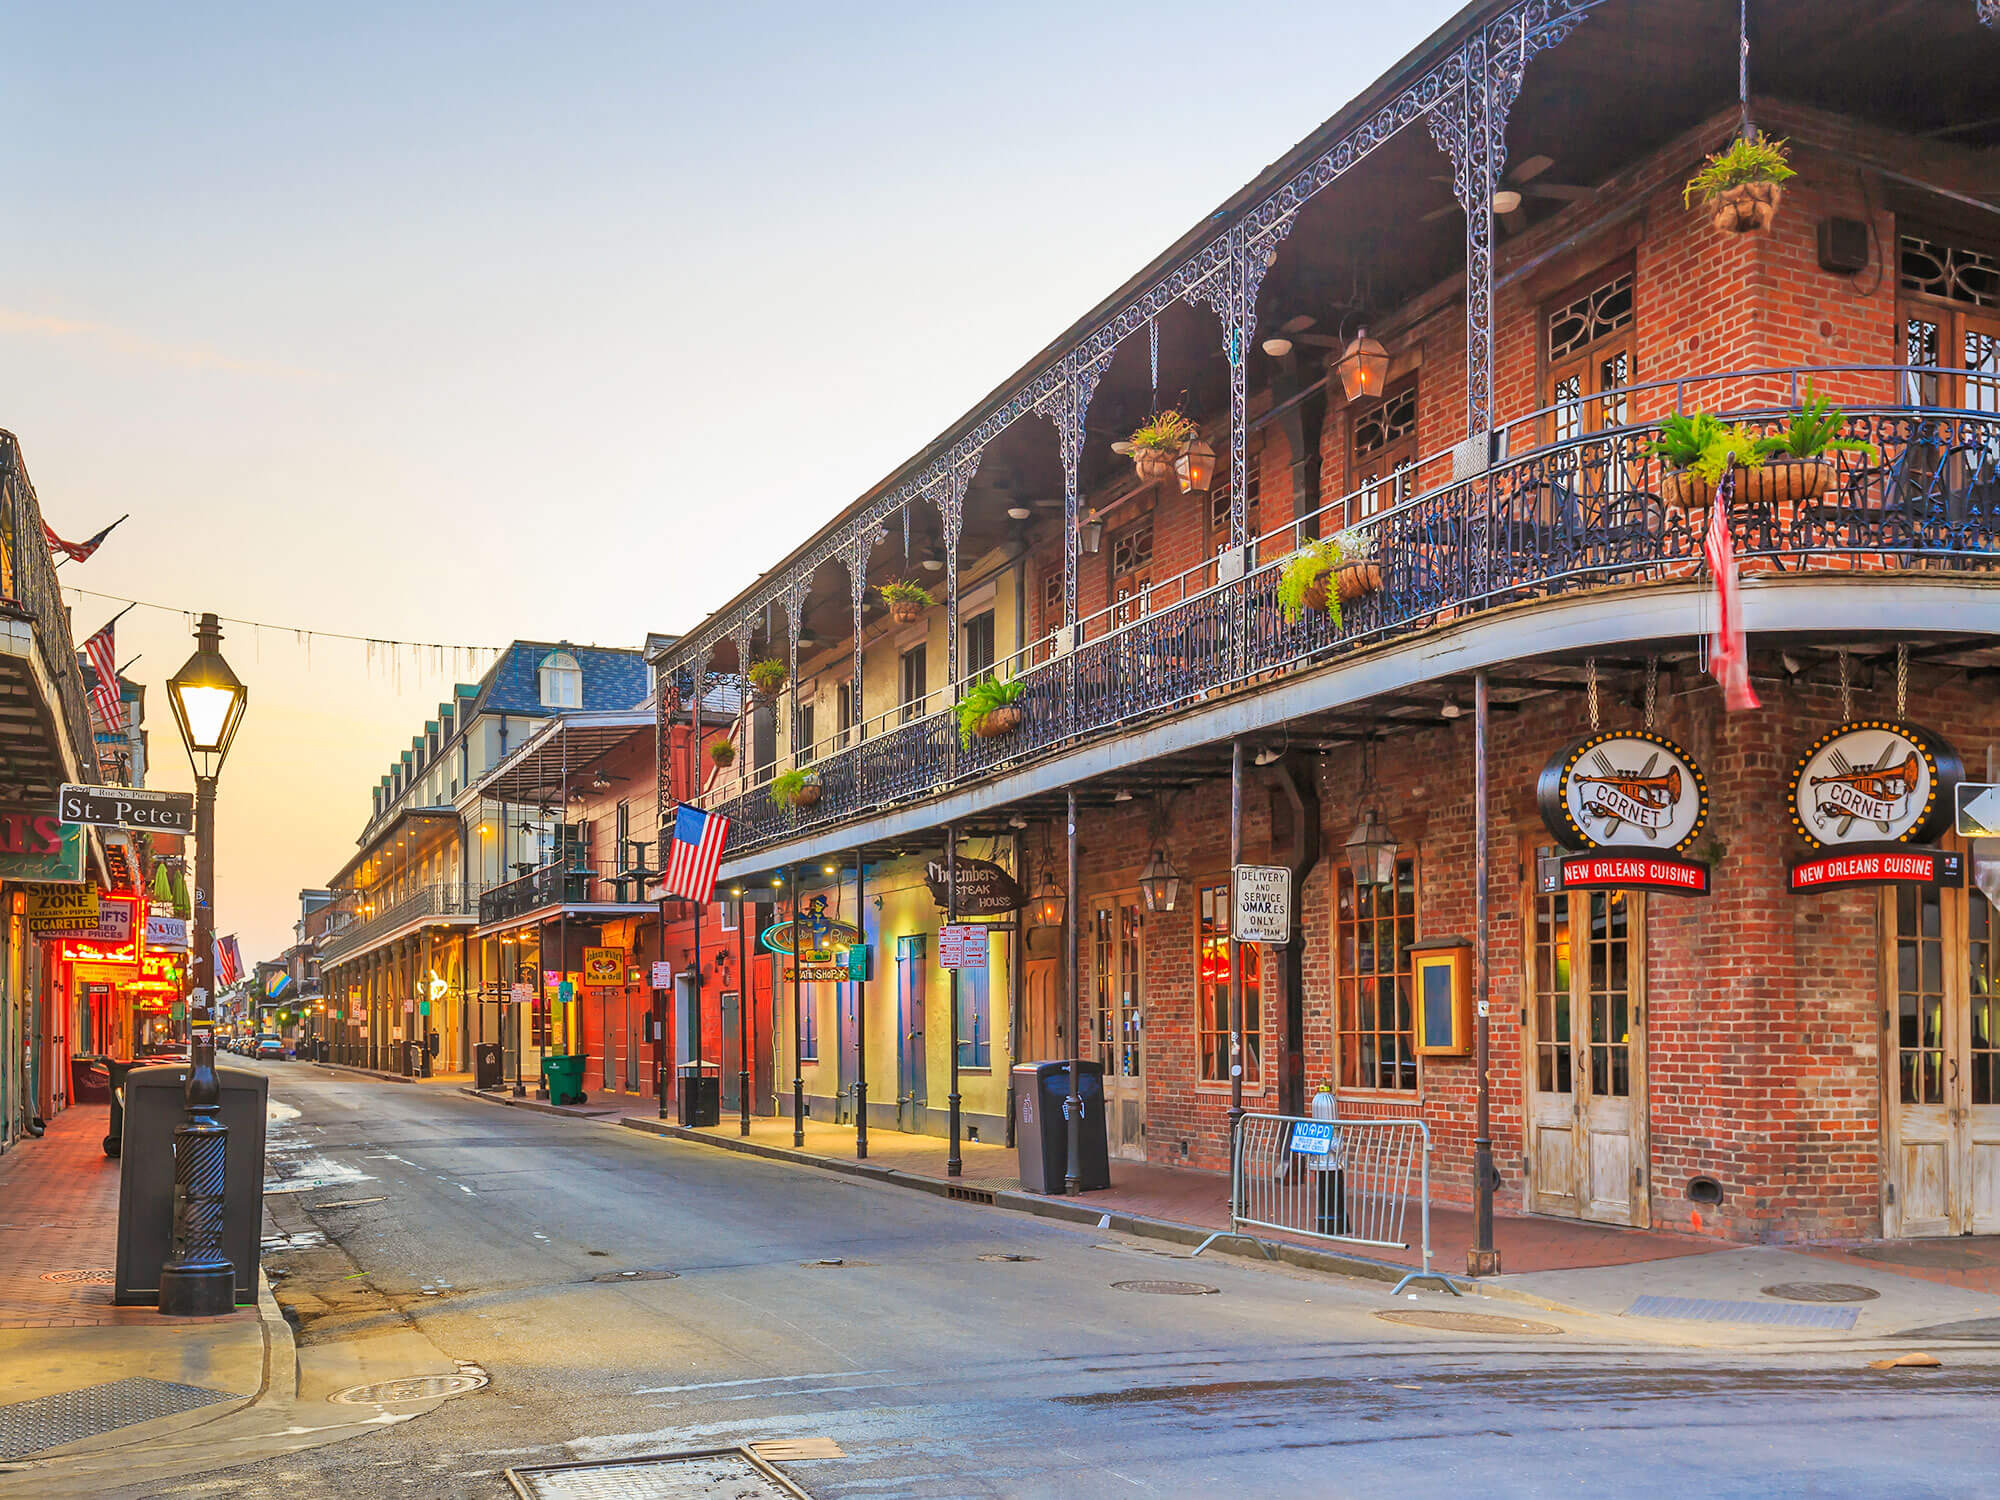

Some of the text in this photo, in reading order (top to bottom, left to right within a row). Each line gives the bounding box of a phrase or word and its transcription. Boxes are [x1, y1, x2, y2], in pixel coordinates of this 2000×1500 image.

[1596, 785, 1661, 827] CORNET
[1830, 784, 1894, 819] CORNET
[66, 798, 186, 825] St. Peter
[955, 862, 999, 883] Embers
[1242, 871, 1284, 883] DELIVERY
[1564, 863, 1696, 885] NEW ORLEANS CUISINE
[1800, 865, 1824, 883] NEW
[1828, 858, 1879, 877] ORLEANS
[1884, 858, 1933, 876] CUISINE
[28, 882, 96, 896] SMOKE
[955, 885, 990, 895] STEAK
[1256, 884, 1270, 892] AND
[38, 895, 88, 908] ZONE
[979, 897, 1011, 907] HOUSE
[1244, 892, 1281, 902] SERVICE
[99, 911, 128, 922] IFTS
[1250, 916, 1274, 925] ONLY
[31, 917, 99, 930] CIGARETTES
[816, 969, 837, 980] SHOP
